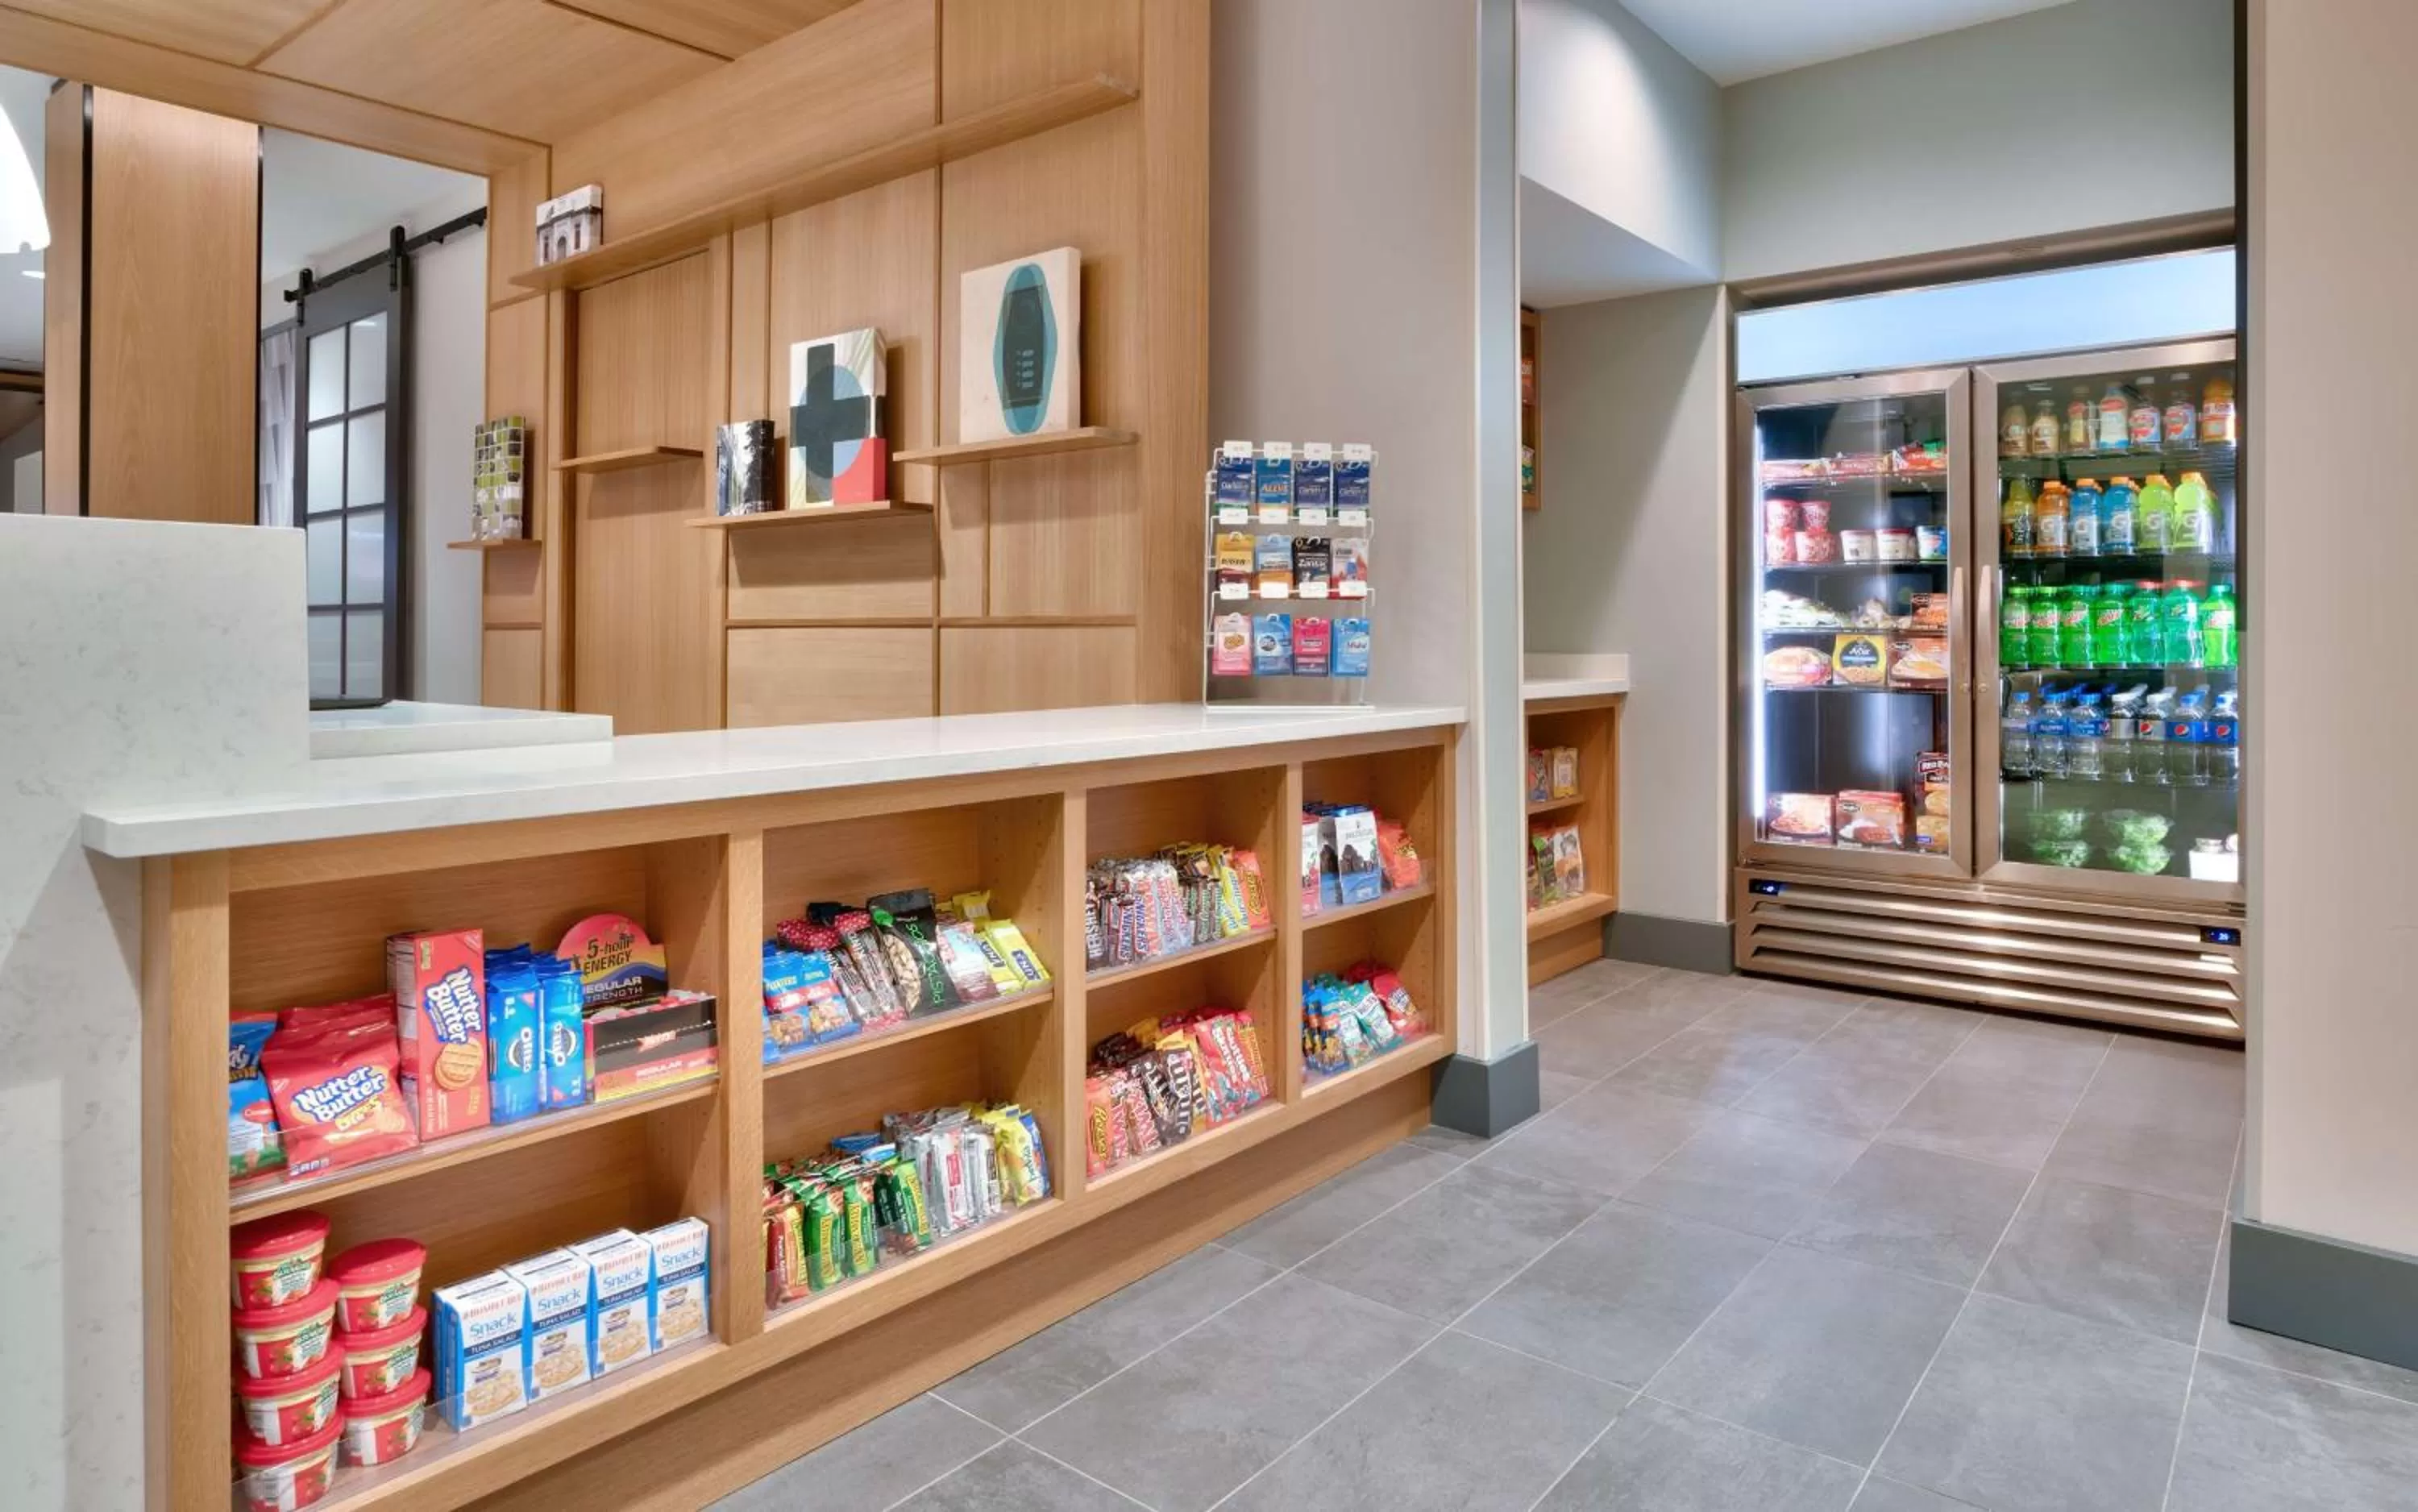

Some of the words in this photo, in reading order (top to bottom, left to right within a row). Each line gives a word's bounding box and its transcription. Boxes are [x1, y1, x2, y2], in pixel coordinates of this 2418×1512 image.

[1120, 904, 1133, 960] SNICKERS
[582, 949, 633, 975] ENERGY
[584, 976, 642, 995] EGULAR
[585, 987, 643, 1003] TRENGTH
[445, 967, 482, 1032] Nutter
[426, 982, 468, 1044] Butter
[295, 1065, 372, 1111] Nutter
[317, 1074, 385, 1122] Butter
[662, 1248, 700, 1266] Snack
[604, 1265, 644, 1287] Snack
[538, 1290, 581, 1311] Snack
[469, 1312, 517, 1337] Snack
